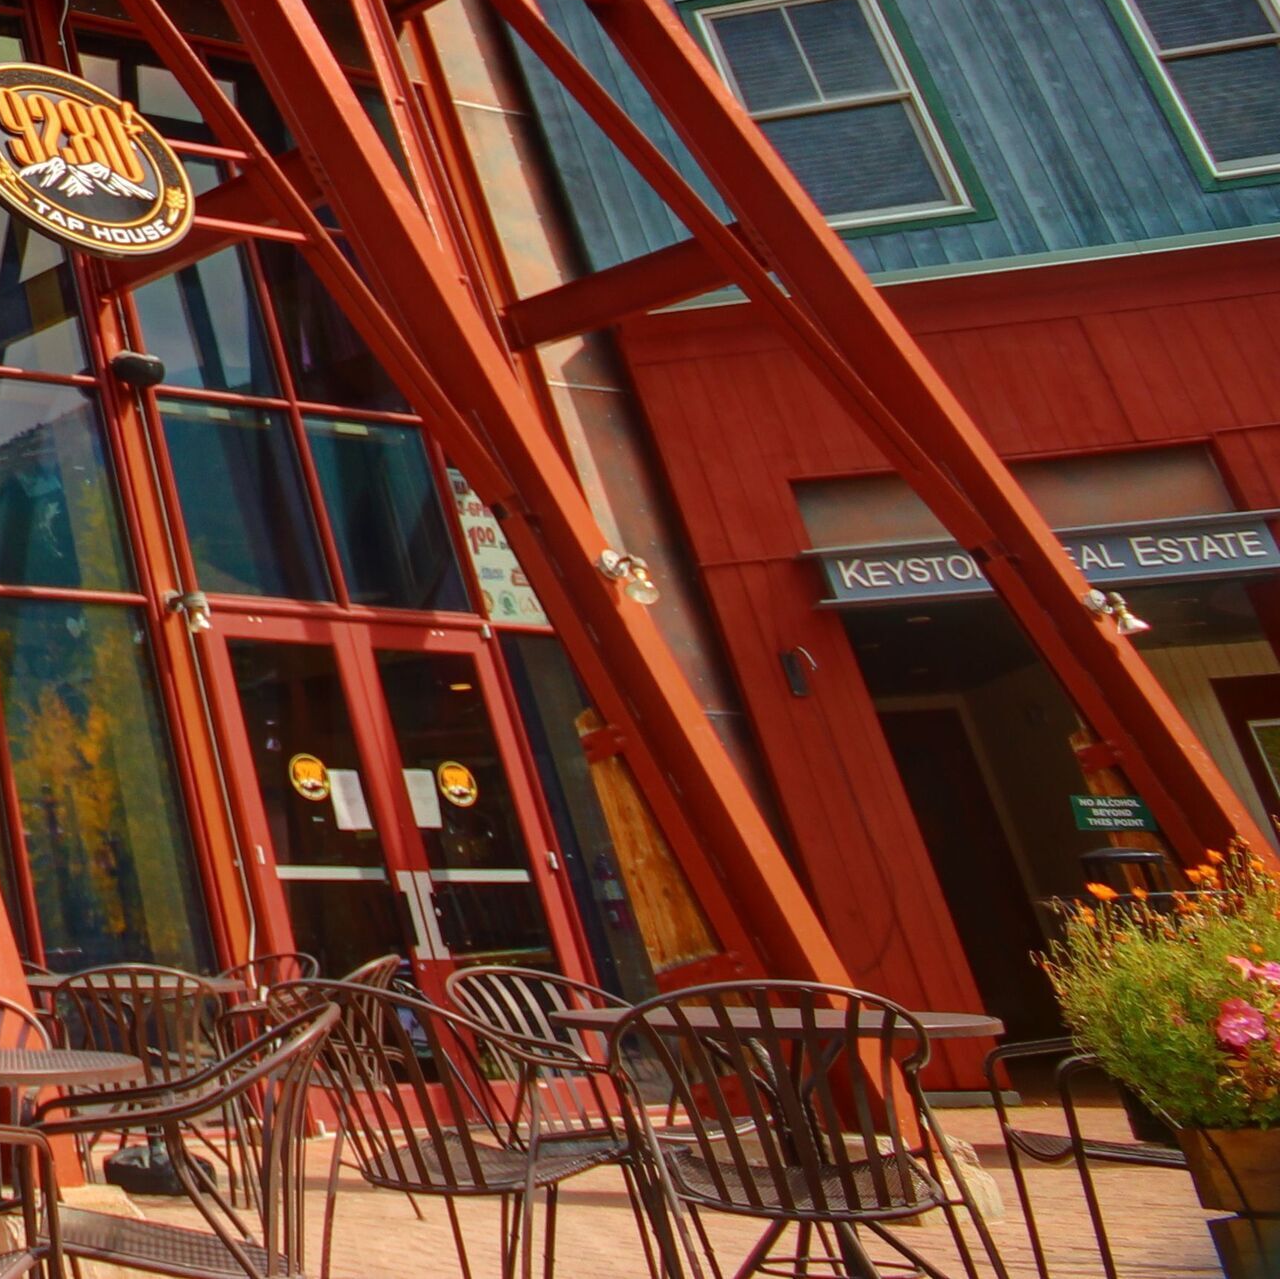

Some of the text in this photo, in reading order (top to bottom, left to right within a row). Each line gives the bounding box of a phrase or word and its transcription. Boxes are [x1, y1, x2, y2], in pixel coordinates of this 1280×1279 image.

[33, 198, 171, 244] TAP HOUSE
[1128, 531, 1268, 567] ESTATE
[1079, 798, 1141, 807] NO ALCOHOL
[1091, 808, 1132, 817] BEYOND
[1087, 817, 1144, 827] THIS POINT
